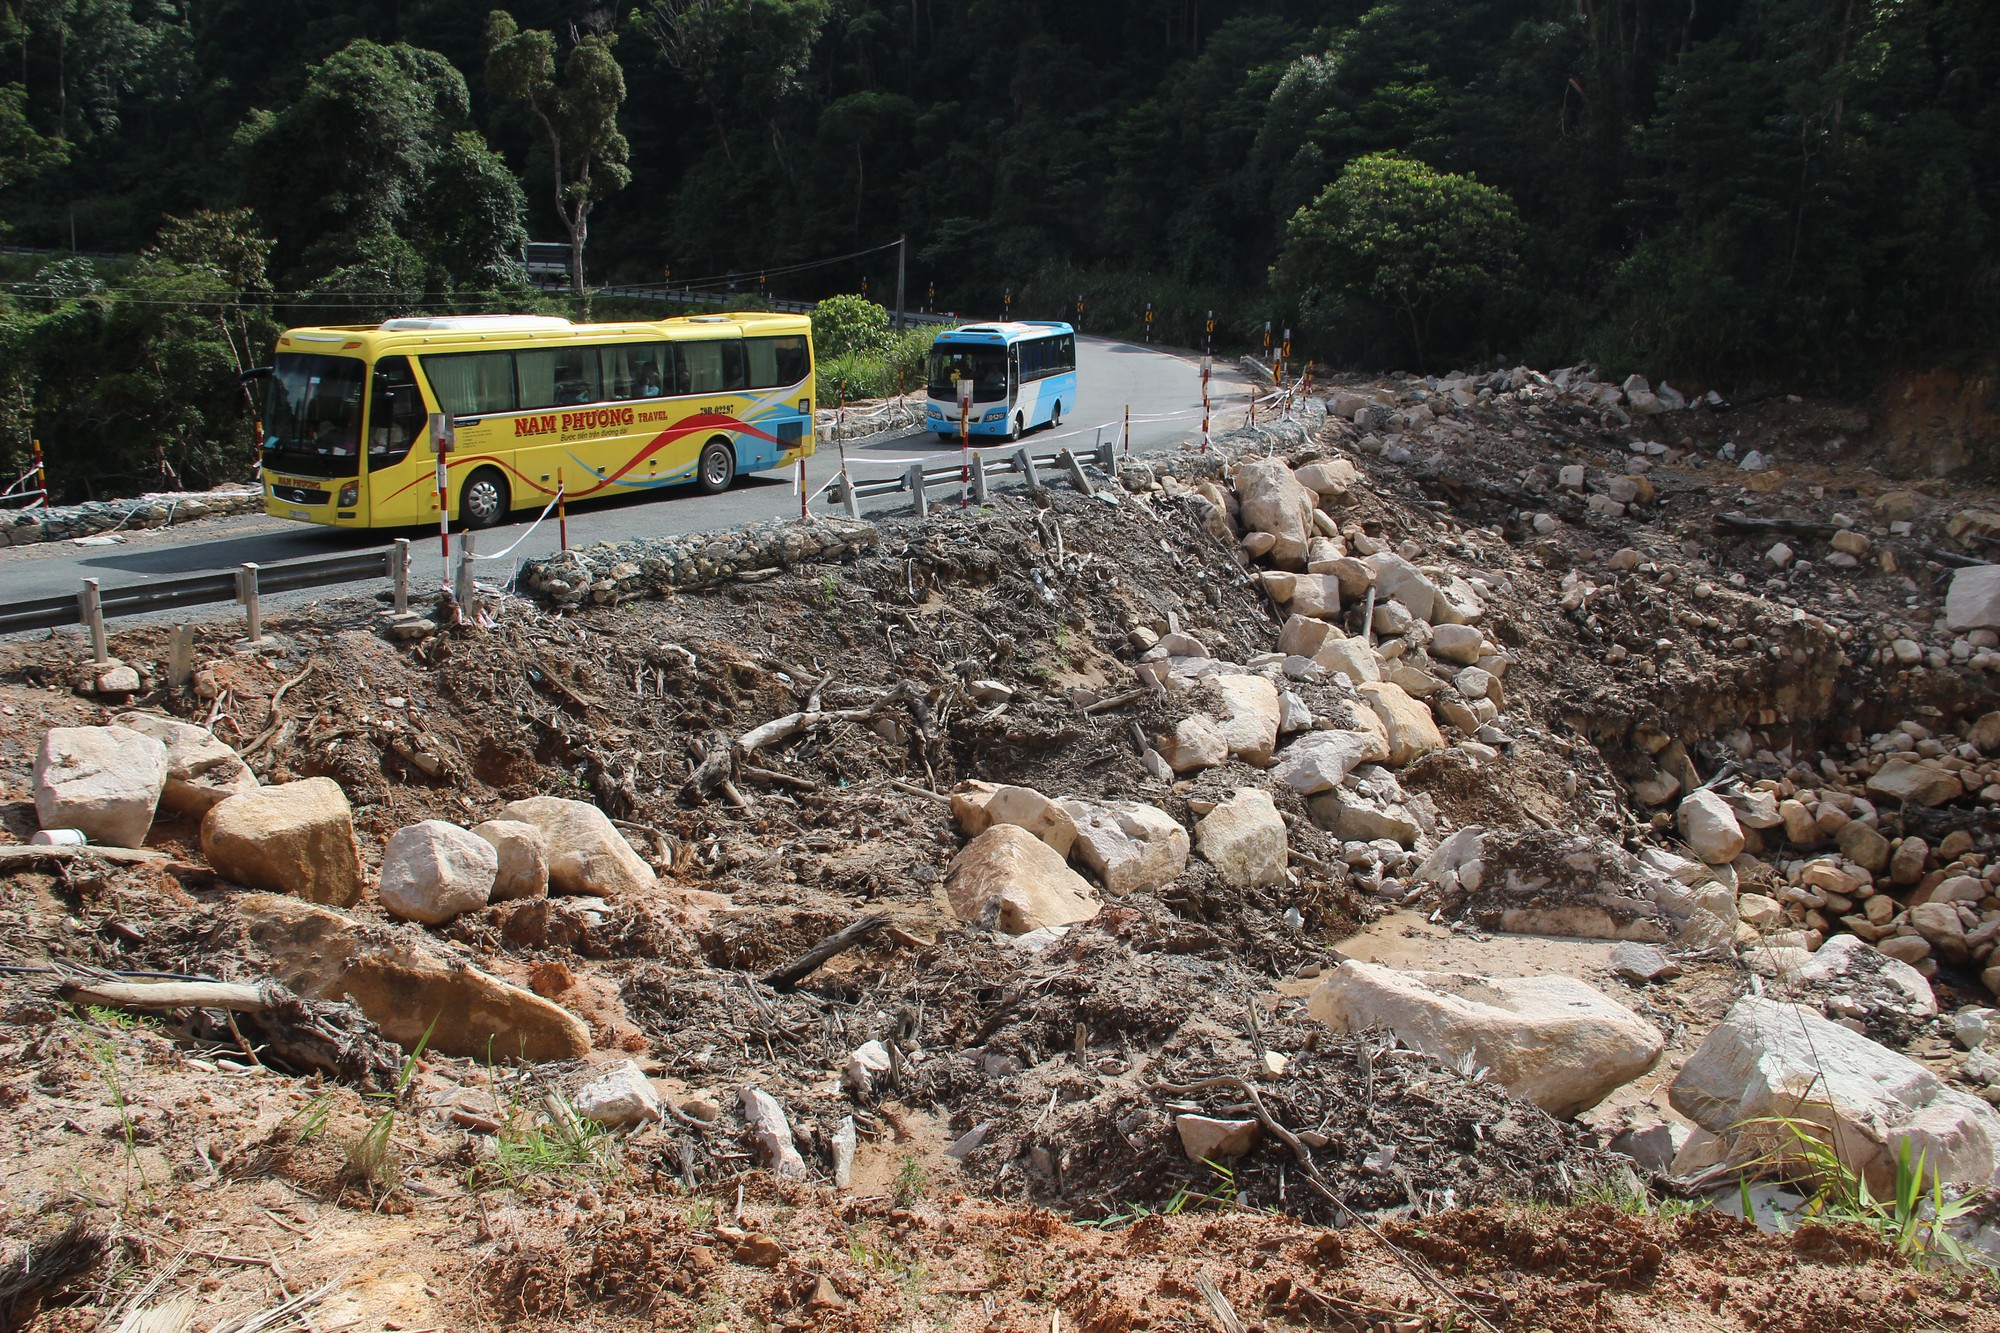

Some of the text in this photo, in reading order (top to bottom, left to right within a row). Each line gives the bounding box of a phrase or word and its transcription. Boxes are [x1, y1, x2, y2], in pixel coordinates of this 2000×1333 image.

[515, 408, 668, 437] NAM PHƯƠNG TRAVEL
